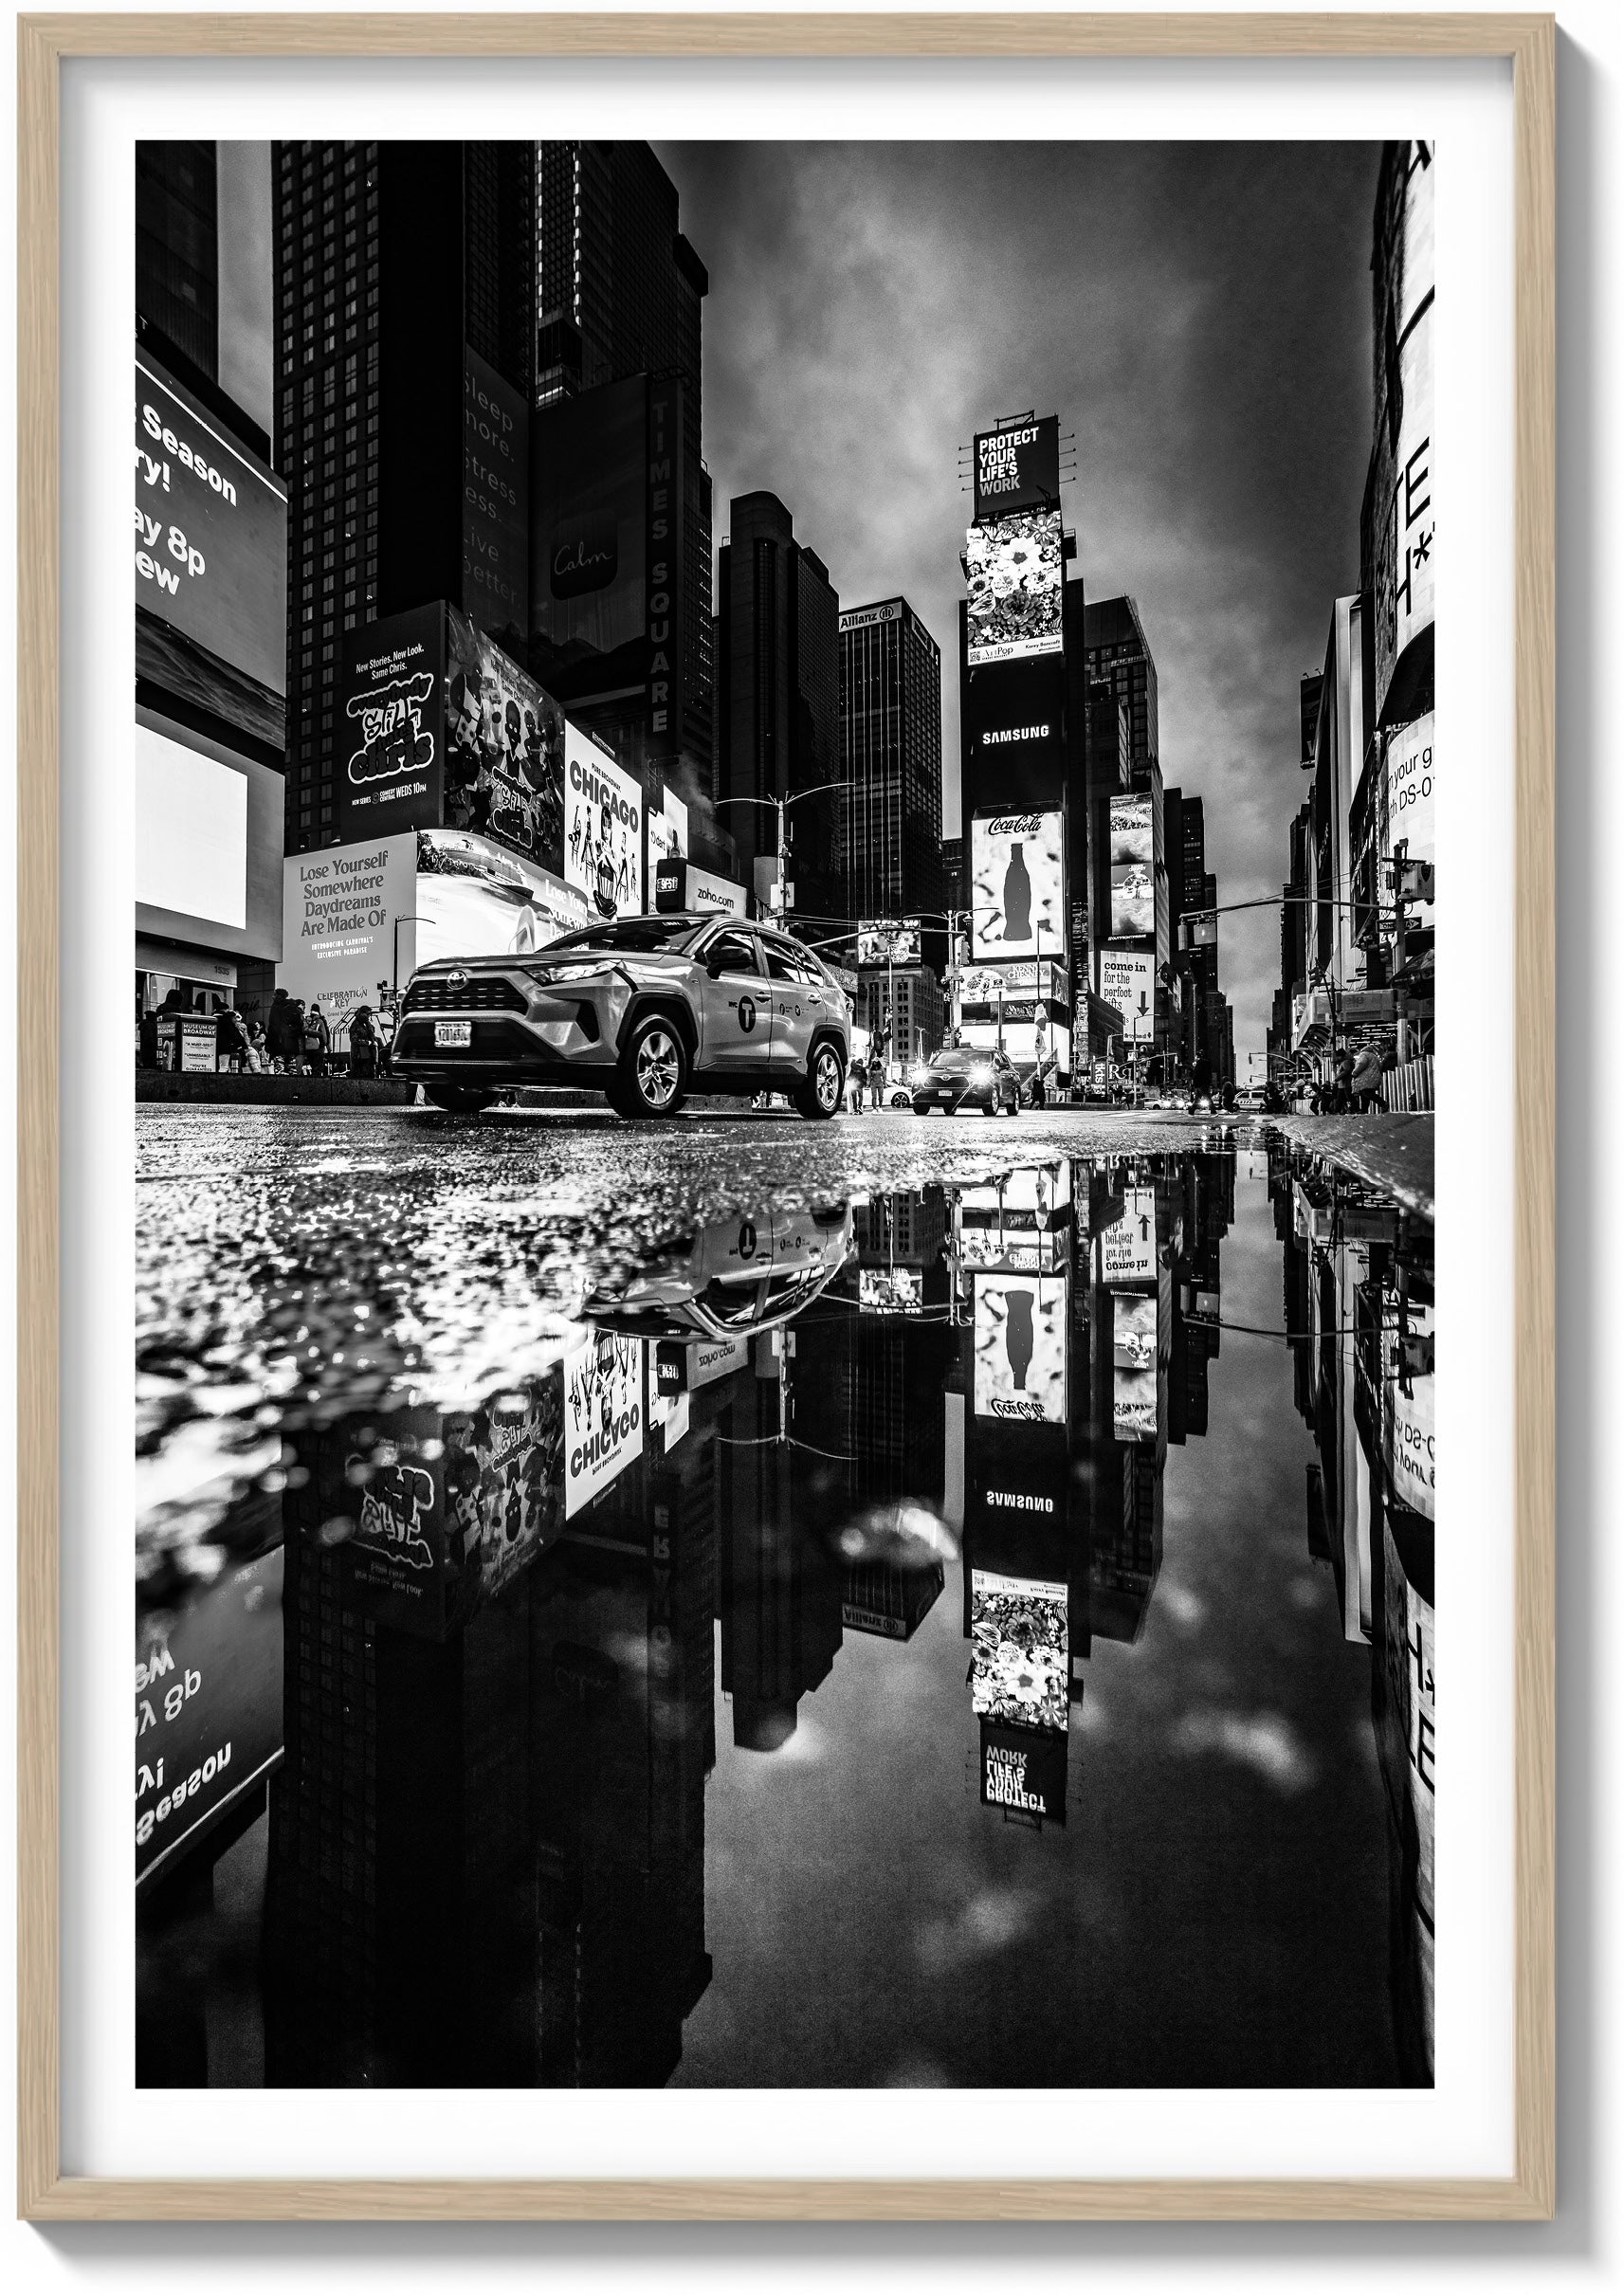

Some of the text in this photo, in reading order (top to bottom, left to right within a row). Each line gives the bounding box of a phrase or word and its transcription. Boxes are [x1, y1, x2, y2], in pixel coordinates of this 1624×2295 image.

[978, 427, 1040, 454] PROTECT
[142, 404, 237, 507] Season
[978, 446, 1016, 468] YOUR
[978, 461, 1018, 483] LIFE'S
[978, 475, 1021, 497] WORK
[168, 525, 206, 577] 8p
[554, 541, 614, 575] Calm
[136, 550, 180, 595] ew
[649, 400, 670, 733] TIMES SQUARE
[840, 612, 878, 628] Allianz
[356, 643, 425, 674] New Stories. New Look.
[371, 662, 408, 681] Same Chris.
[982, 724, 1049, 745] SAMSUNG
[1394, 754, 1418, 791] your
[1422, 746, 1432, 770] g
[395, 784, 412, 798] WEDS
[570, 760, 639, 833] CHICAGO
[1399, 776, 1432, 811] DS-0
[988, 813, 1044, 835] Coca-Cola
[300, 850, 389, 882] Lose Yourself
[303, 875, 384, 900] Somewhere
[698, 887, 735, 909] zoho.com
[305, 895, 381, 920] Daydreams
[301, 909, 387, 938] Are Made Of
[312, 940, 344, 951] INTRODUCING
[317, 947, 368, 959] EXCLUSIVE PARADISE
[1104, 961, 1147, 973] come in
[1104, 971, 1130, 984] for the
[335, 998, 350, 1009] KEY
[1104, 986, 1133, 999] perfect
[1106, 998, 1122, 1011] ifts
[1094, 1063, 1105, 1084] tkts
